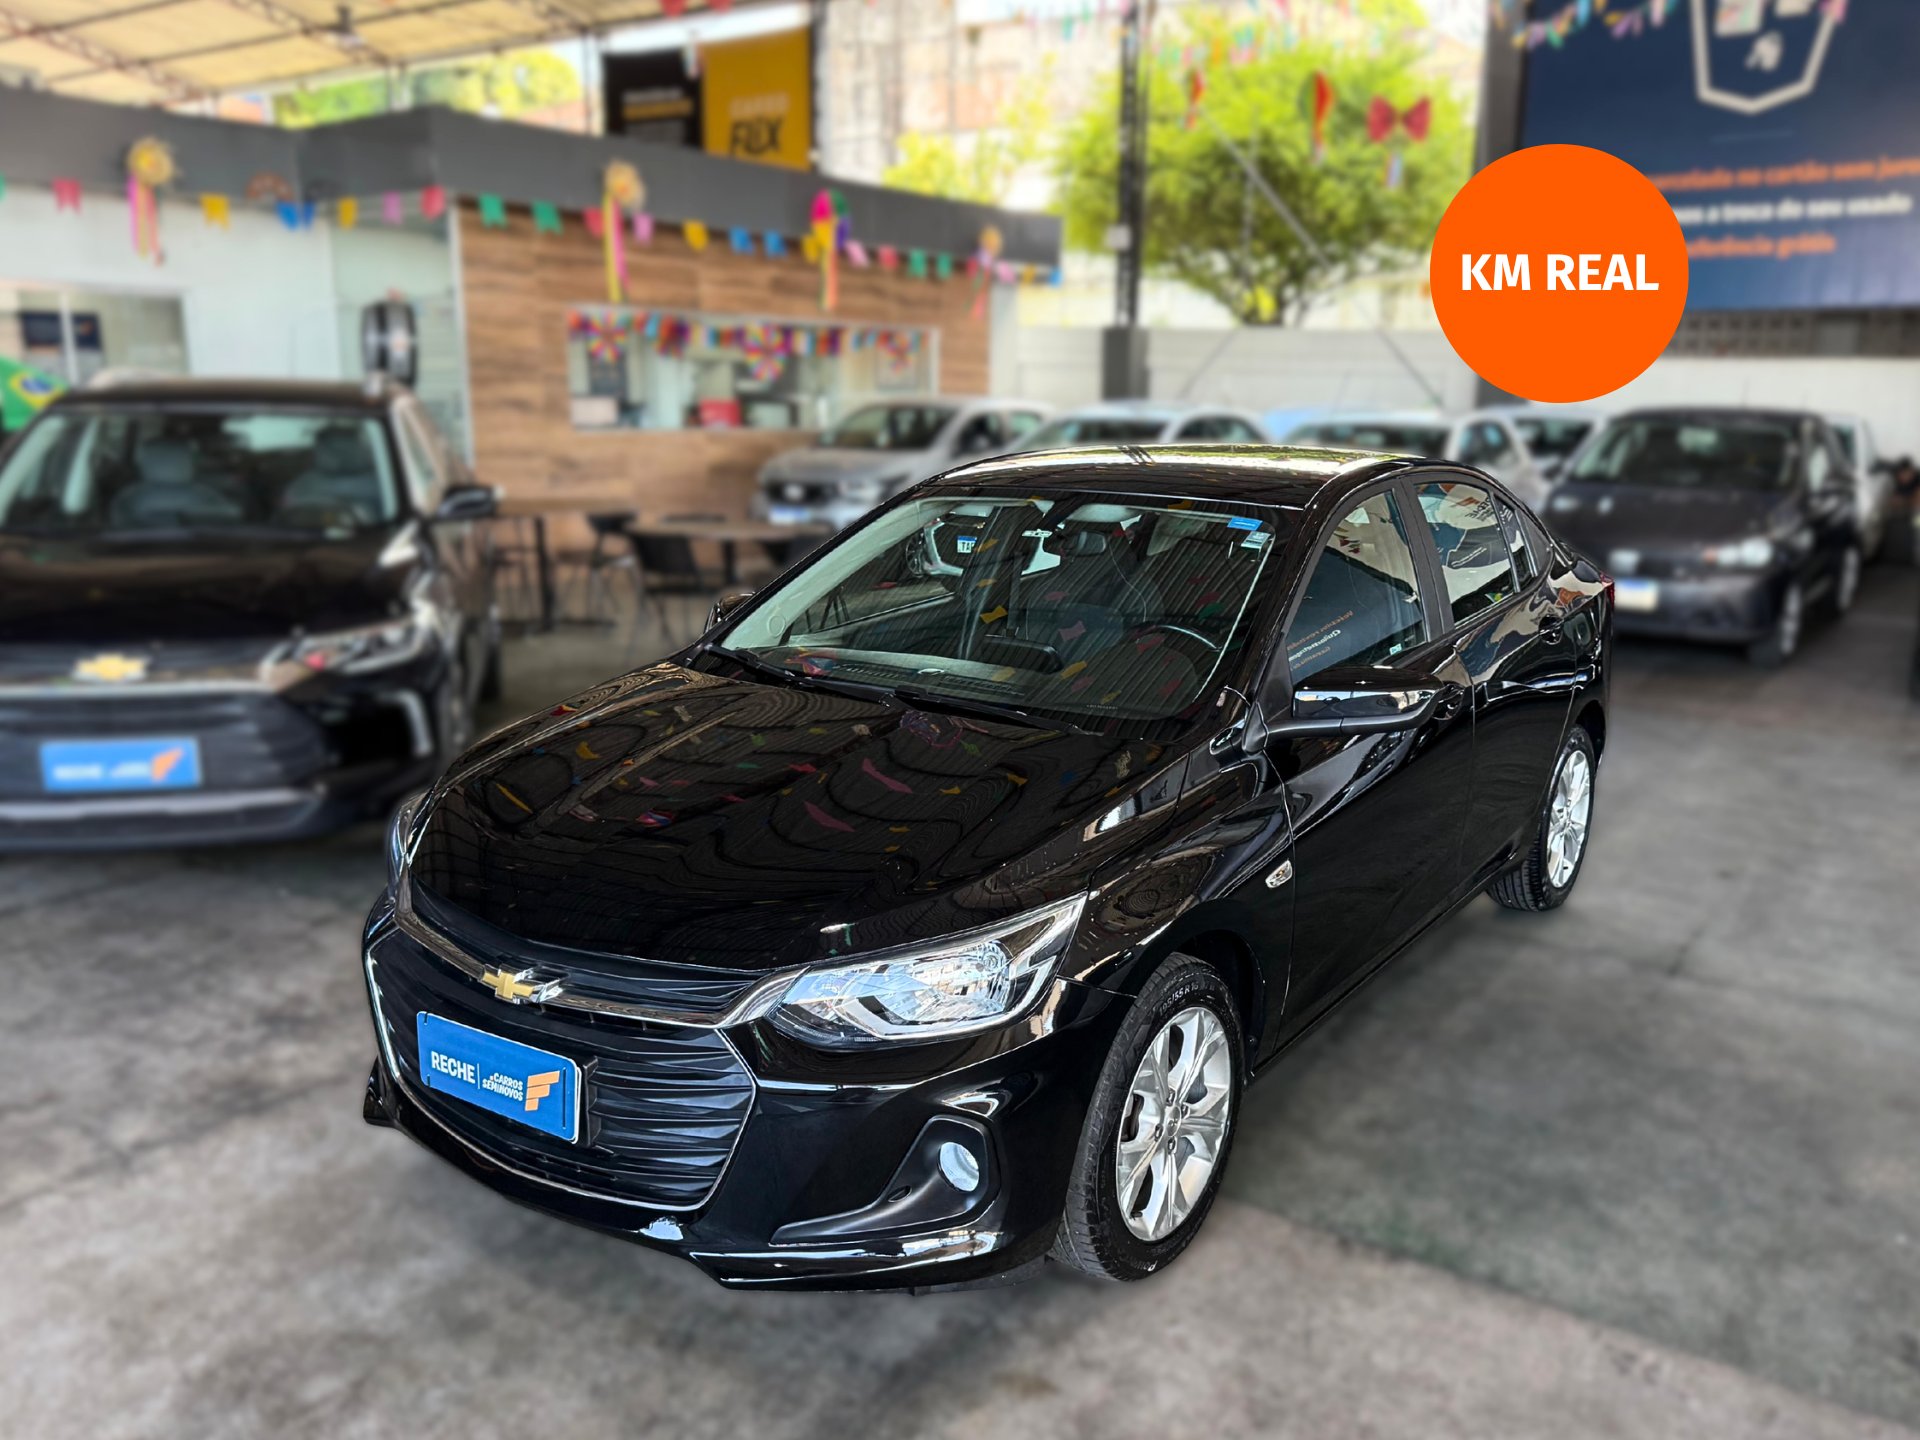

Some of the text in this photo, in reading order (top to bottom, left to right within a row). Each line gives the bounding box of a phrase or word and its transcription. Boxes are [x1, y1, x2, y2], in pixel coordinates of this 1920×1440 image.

[430, 1050, 476, 1084] RECHE
[482, 1078, 523, 1102] SEMINOVOS
[493, 1072, 523, 1091] CARROS
